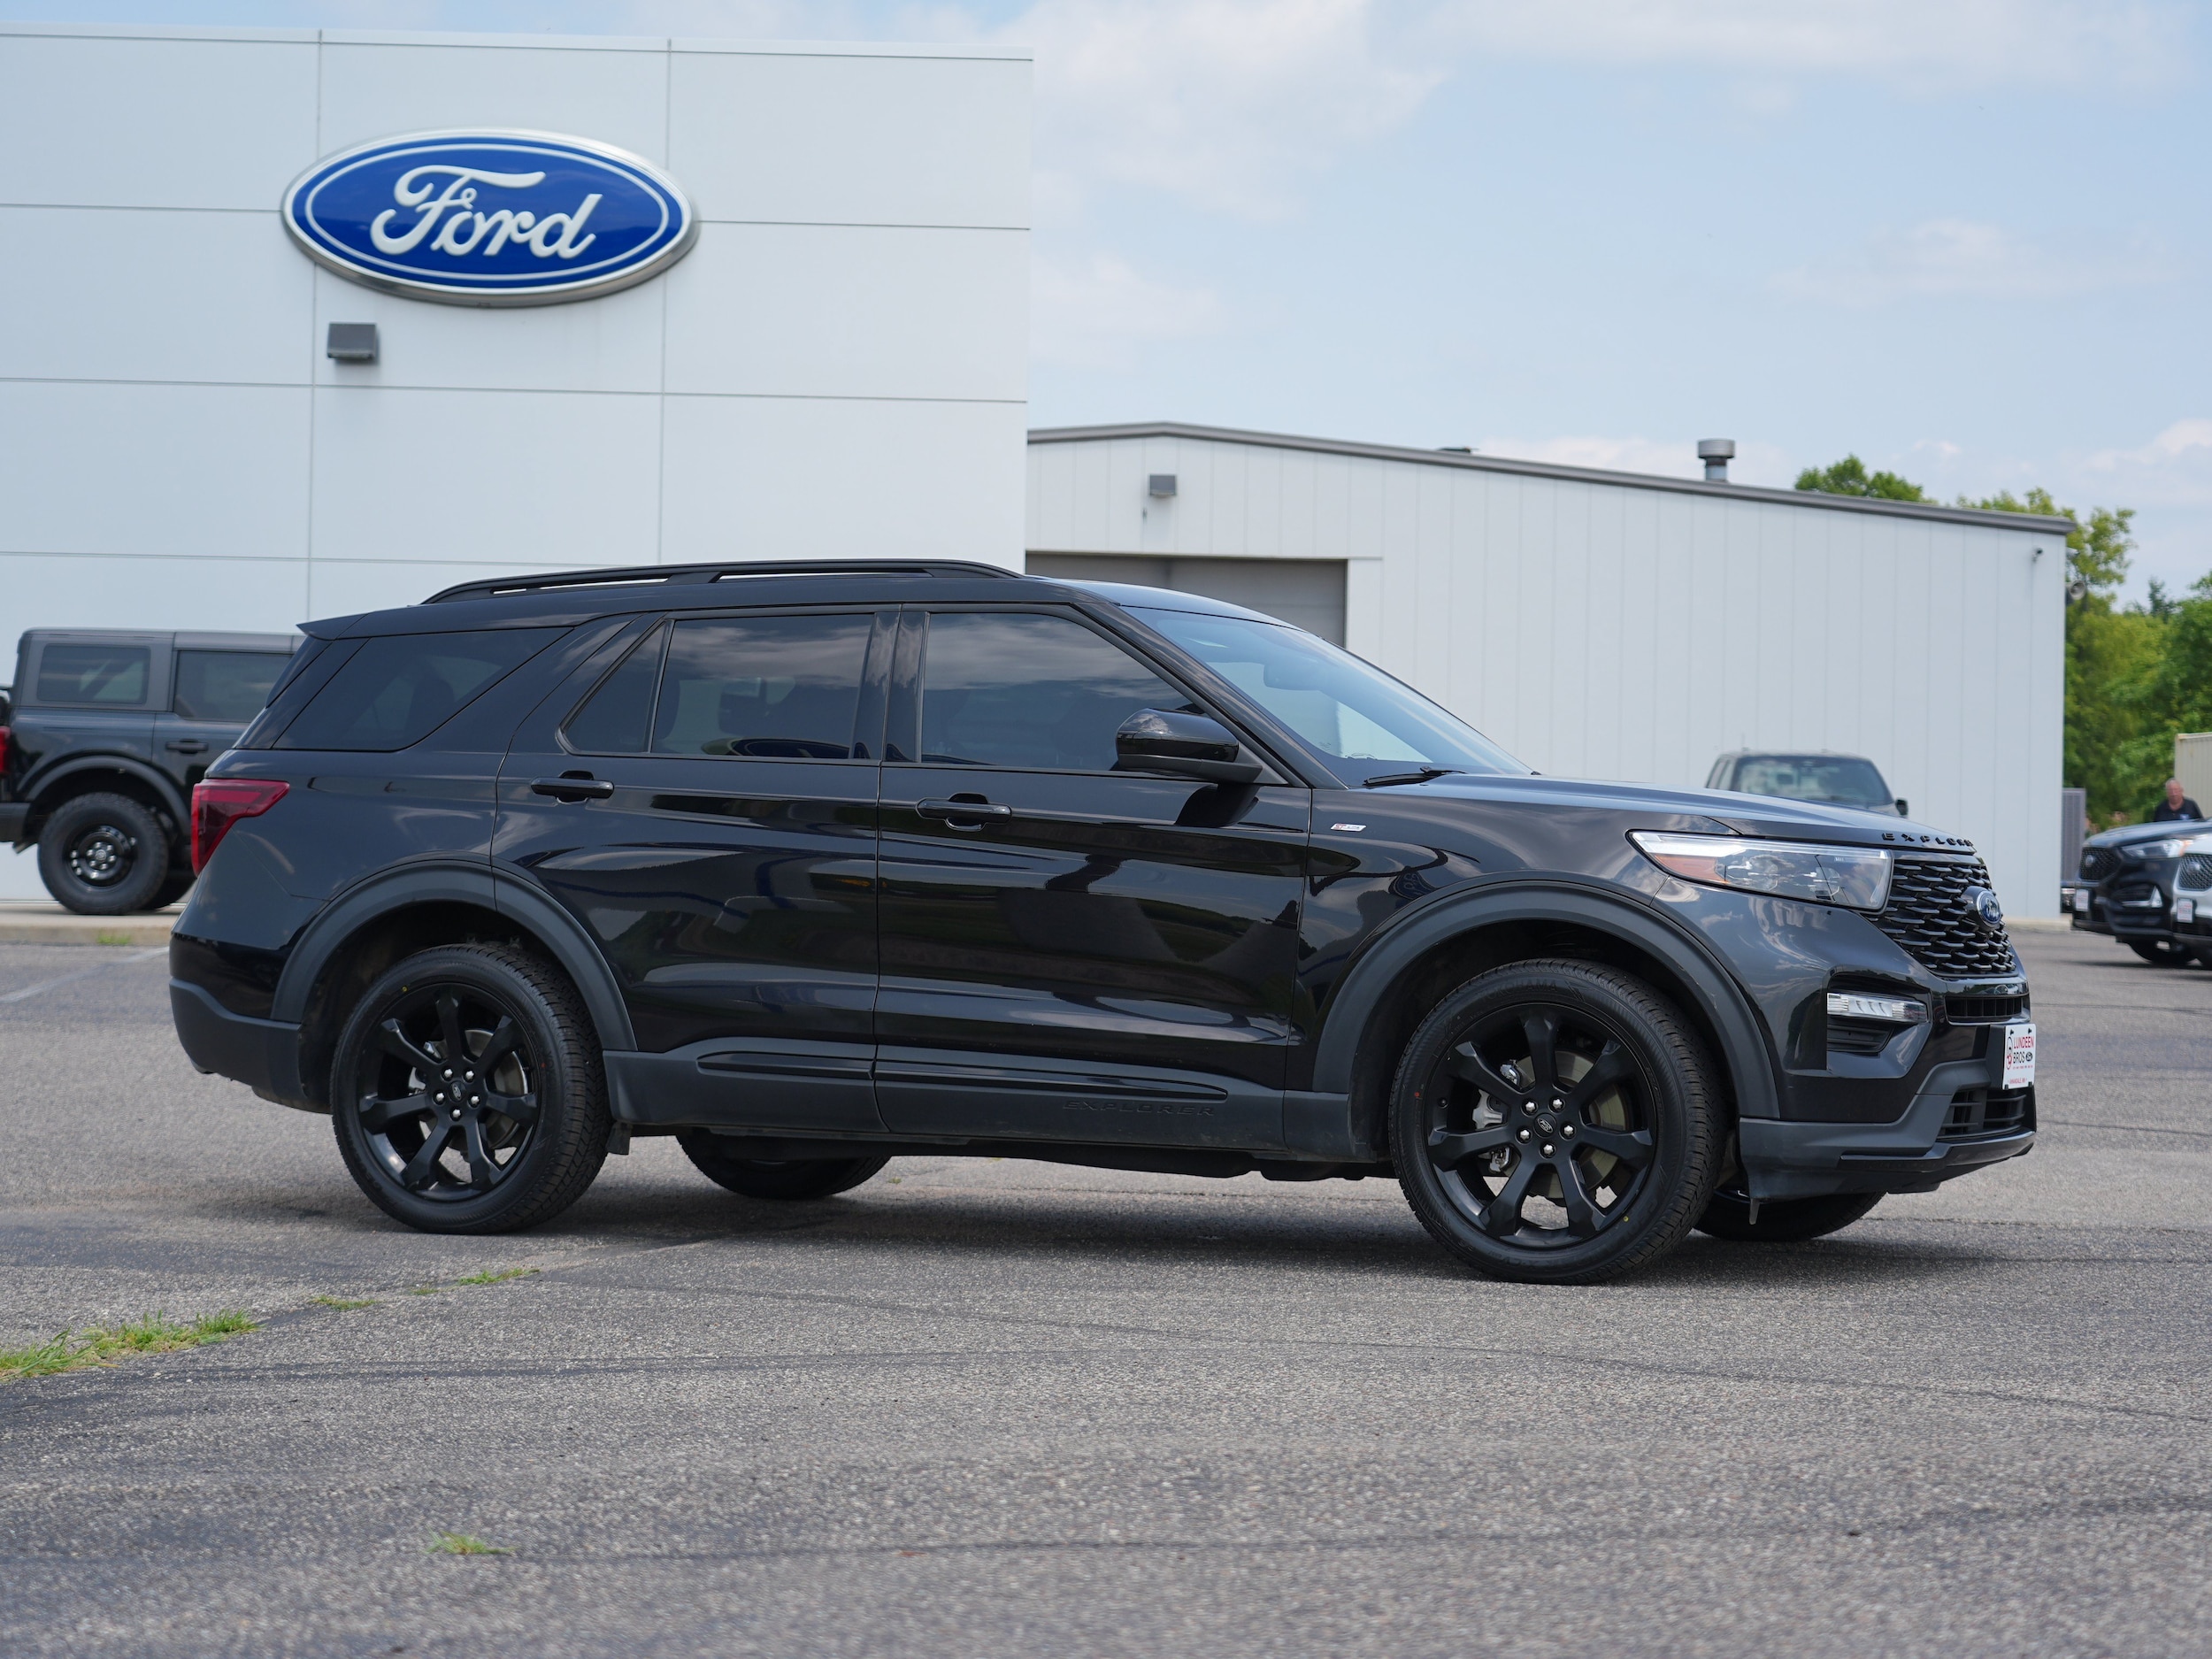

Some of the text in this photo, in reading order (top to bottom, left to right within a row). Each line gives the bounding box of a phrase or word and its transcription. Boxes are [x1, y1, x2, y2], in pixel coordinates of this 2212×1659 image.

[370, 165, 603, 258] Ford
[2014, 1036, 2034, 1049] LUNDEEN
[1063, 1101, 1215, 1117] EXPLORER
